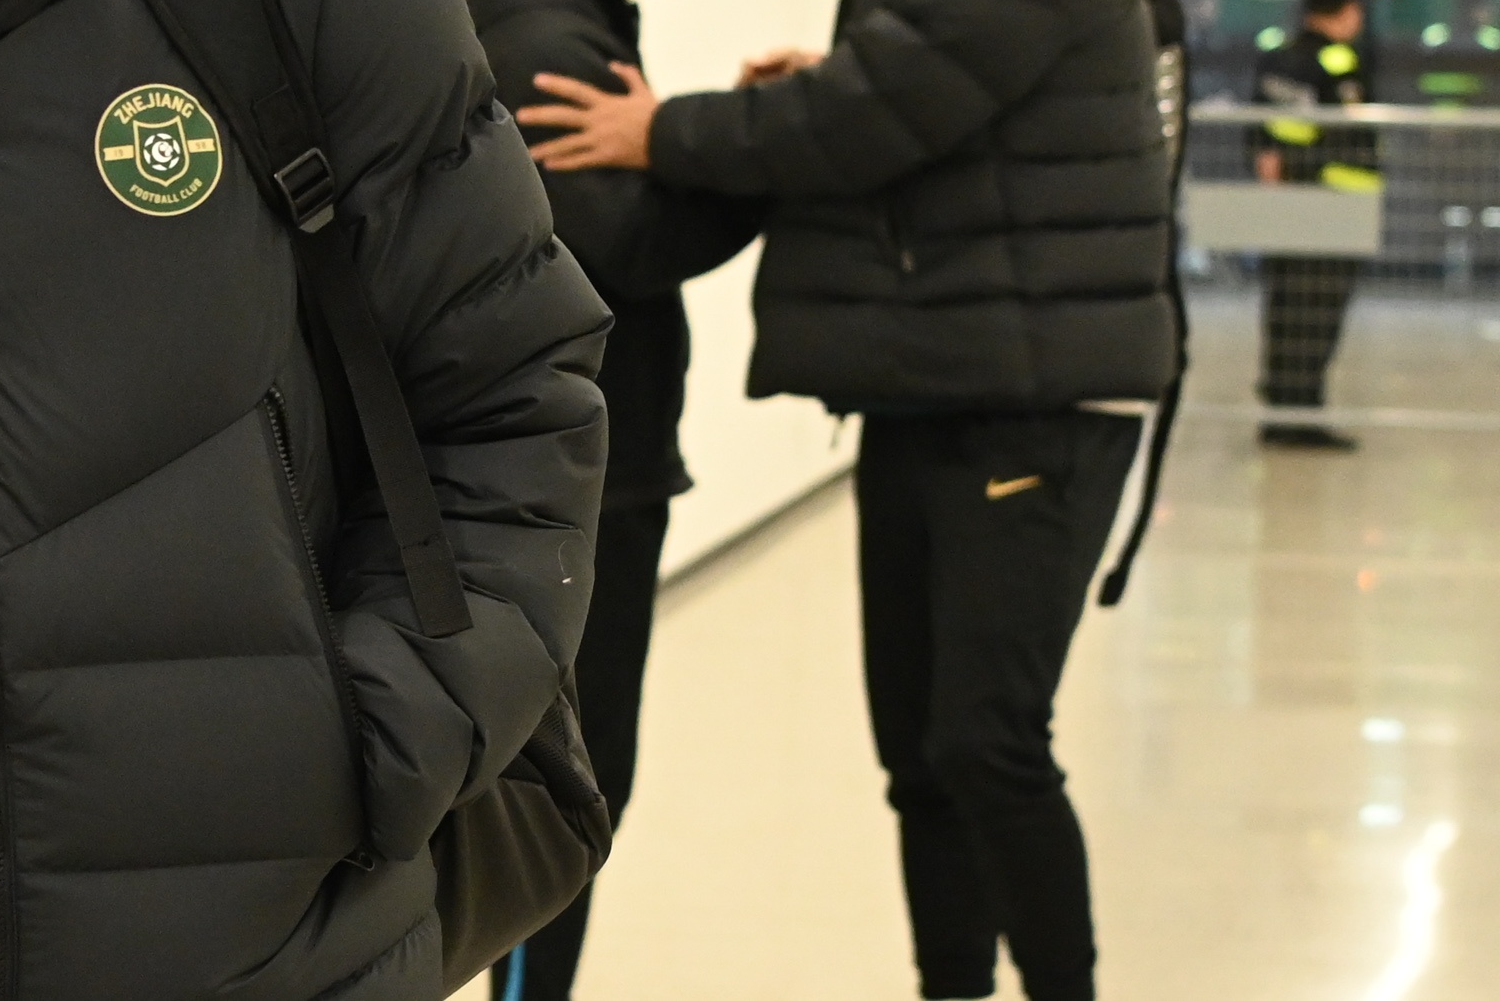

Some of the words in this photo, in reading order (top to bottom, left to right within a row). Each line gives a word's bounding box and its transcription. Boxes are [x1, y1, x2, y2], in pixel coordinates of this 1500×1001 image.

[114, 92, 195, 124] ZHEJIANG
[129, 184, 180, 204] FOOTBALL
[180, 178, 203, 200] CLUB
